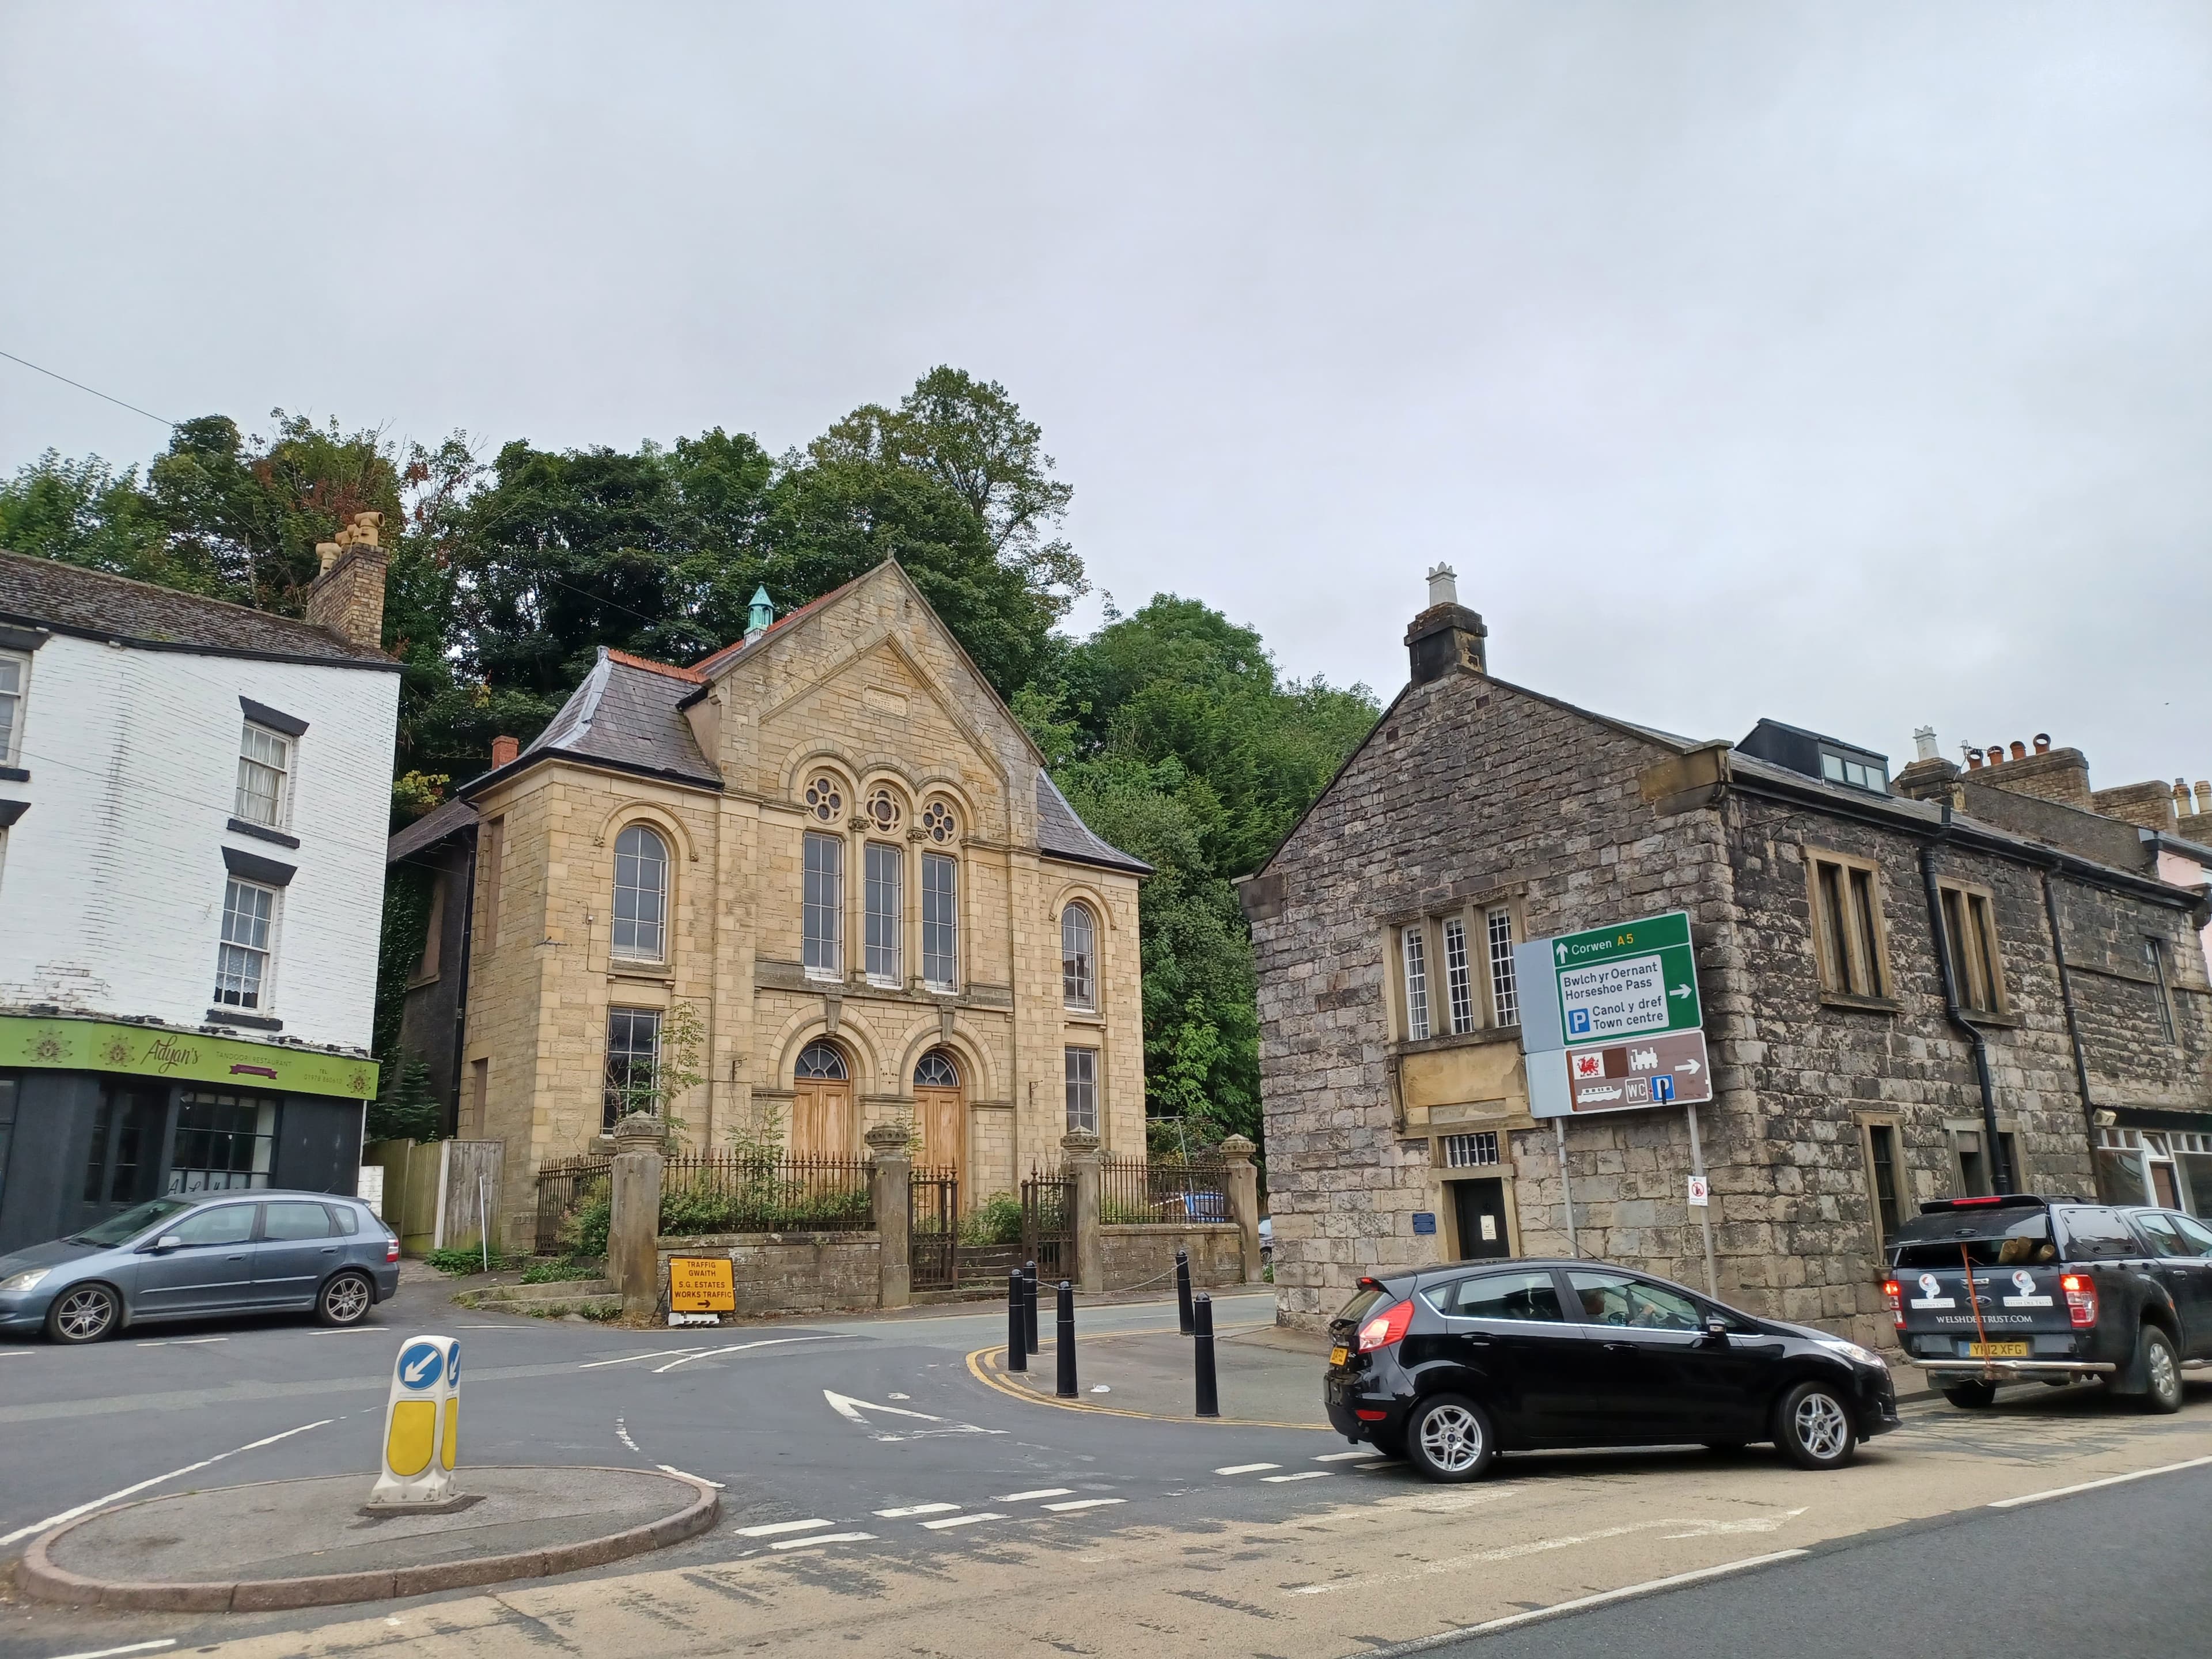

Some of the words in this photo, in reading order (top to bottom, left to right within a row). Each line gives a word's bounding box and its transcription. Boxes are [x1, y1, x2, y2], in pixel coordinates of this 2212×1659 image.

[1571, 940, 1612, 955] Corwen
[1617, 933, 1634, 946] A5
[1563, 973, 1597, 987] Bwlch
[1599, 972, 1609, 983] yr
[1611, 961, 1658, 979] Oernant
[1565, 984, 1623, 1001] Horseshoe
[1626, 979, 1652, 990] Pass
[1592, 1002, 1625, 1016] Canol
[1628, 1003, 1634, 1013] y
[1638, 995, 1662, 1009] dref
[1573, 1011, 1586, 1032] P
[1593, 1018, 1623, 1030] Town
[1626, 1012, 1664, 1026] centre
[140, 1035, 202, 1074] Adyan's
[216, 1051, 250, 1062] TANDOORI
[252, 1056, 292, 1067] RESTAURANT
[1627, 1083, 1646, 1097] WC
[1999, 1344, 2022, 1354] XFG
